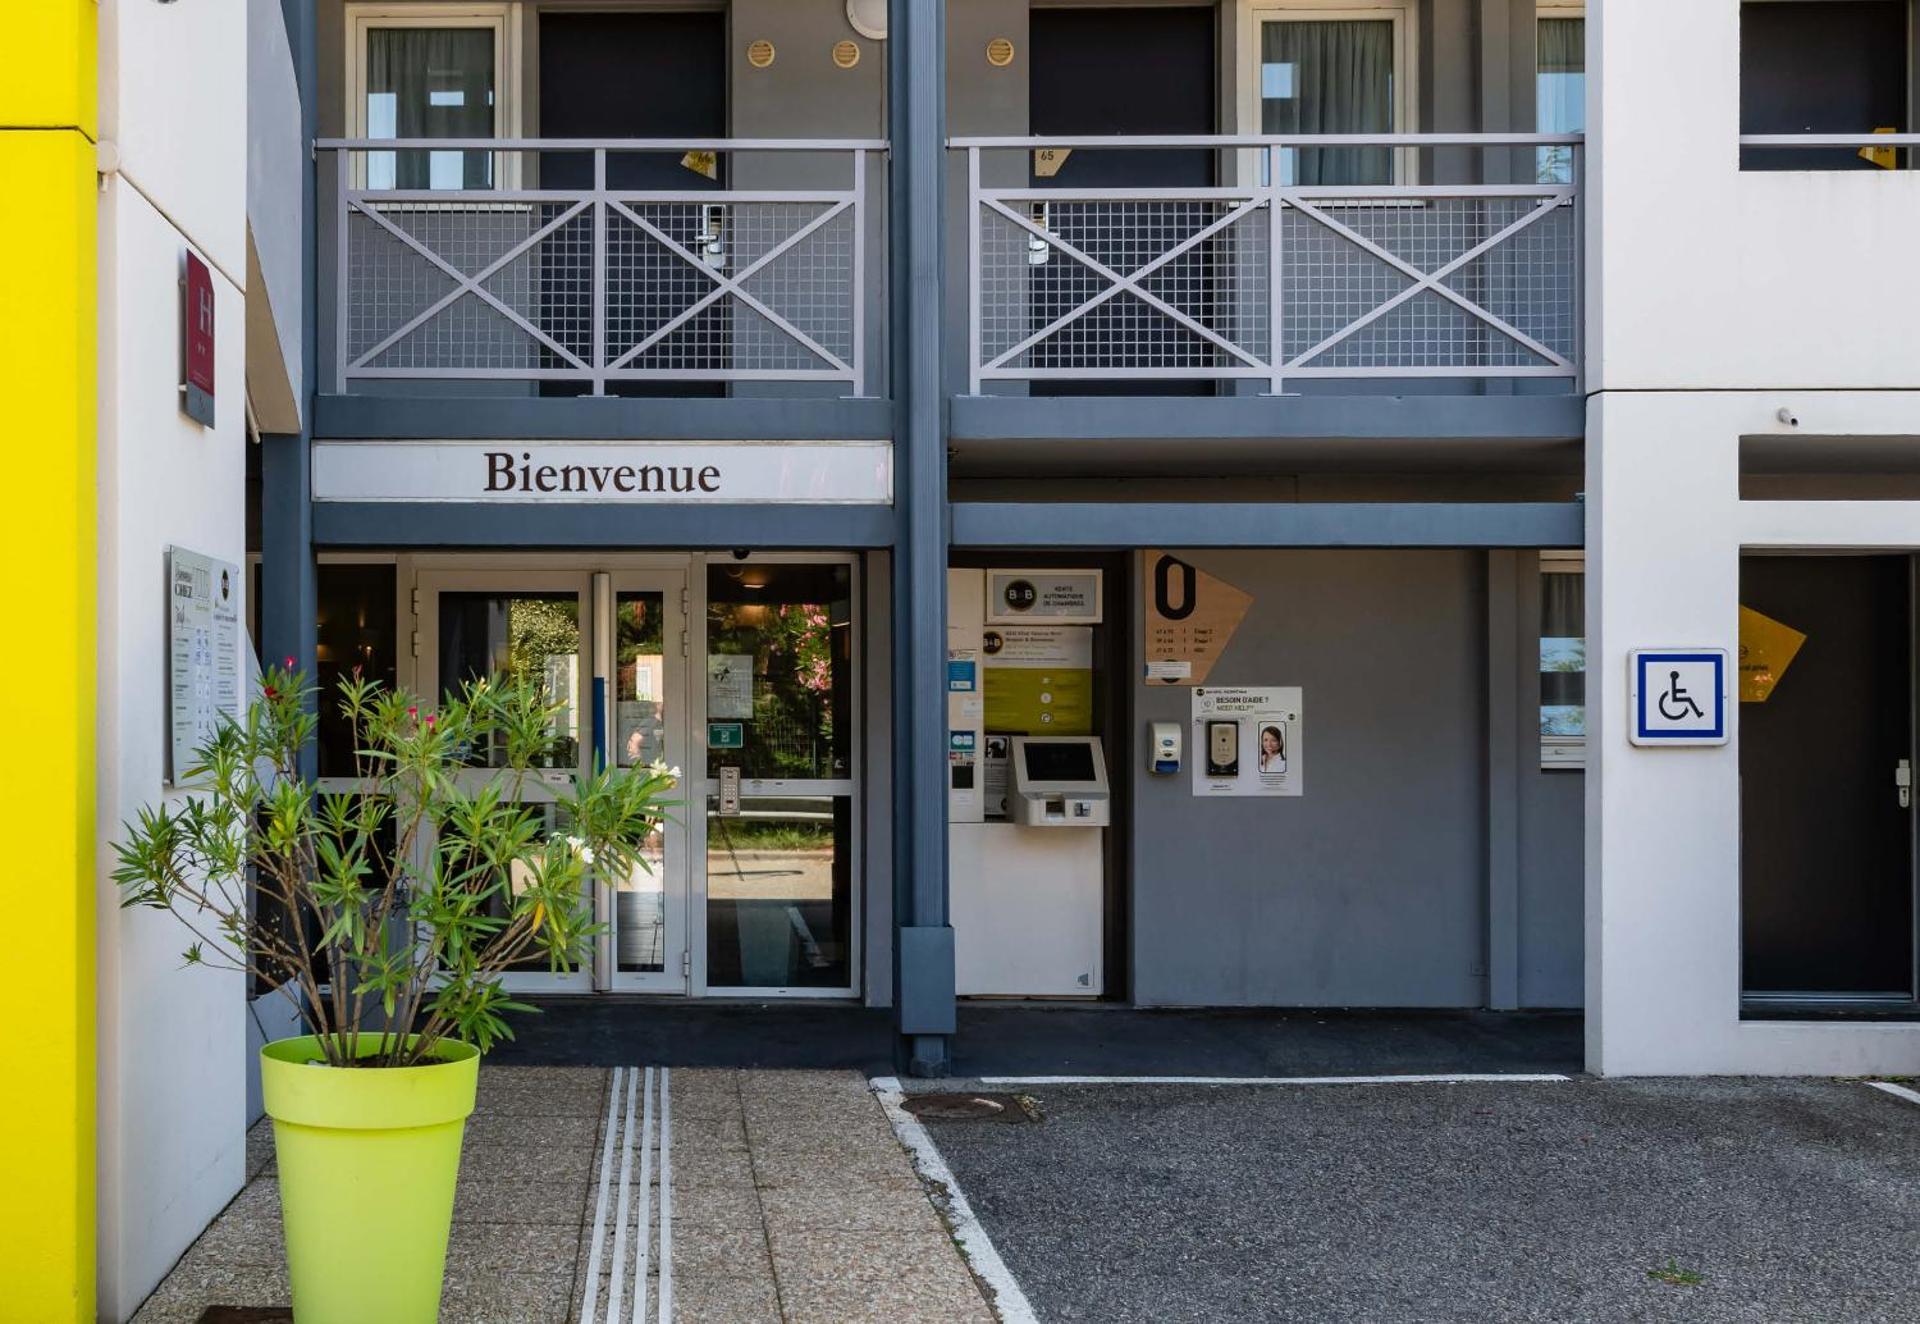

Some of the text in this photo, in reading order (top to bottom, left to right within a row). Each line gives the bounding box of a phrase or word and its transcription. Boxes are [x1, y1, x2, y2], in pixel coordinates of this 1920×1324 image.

[1041, 150, 1054, 161] 65
[199, 286, 212, 338] H
[483, 452, 721, 492] Bienvenue
[1216, 696, 1241, 704] BESOIN
